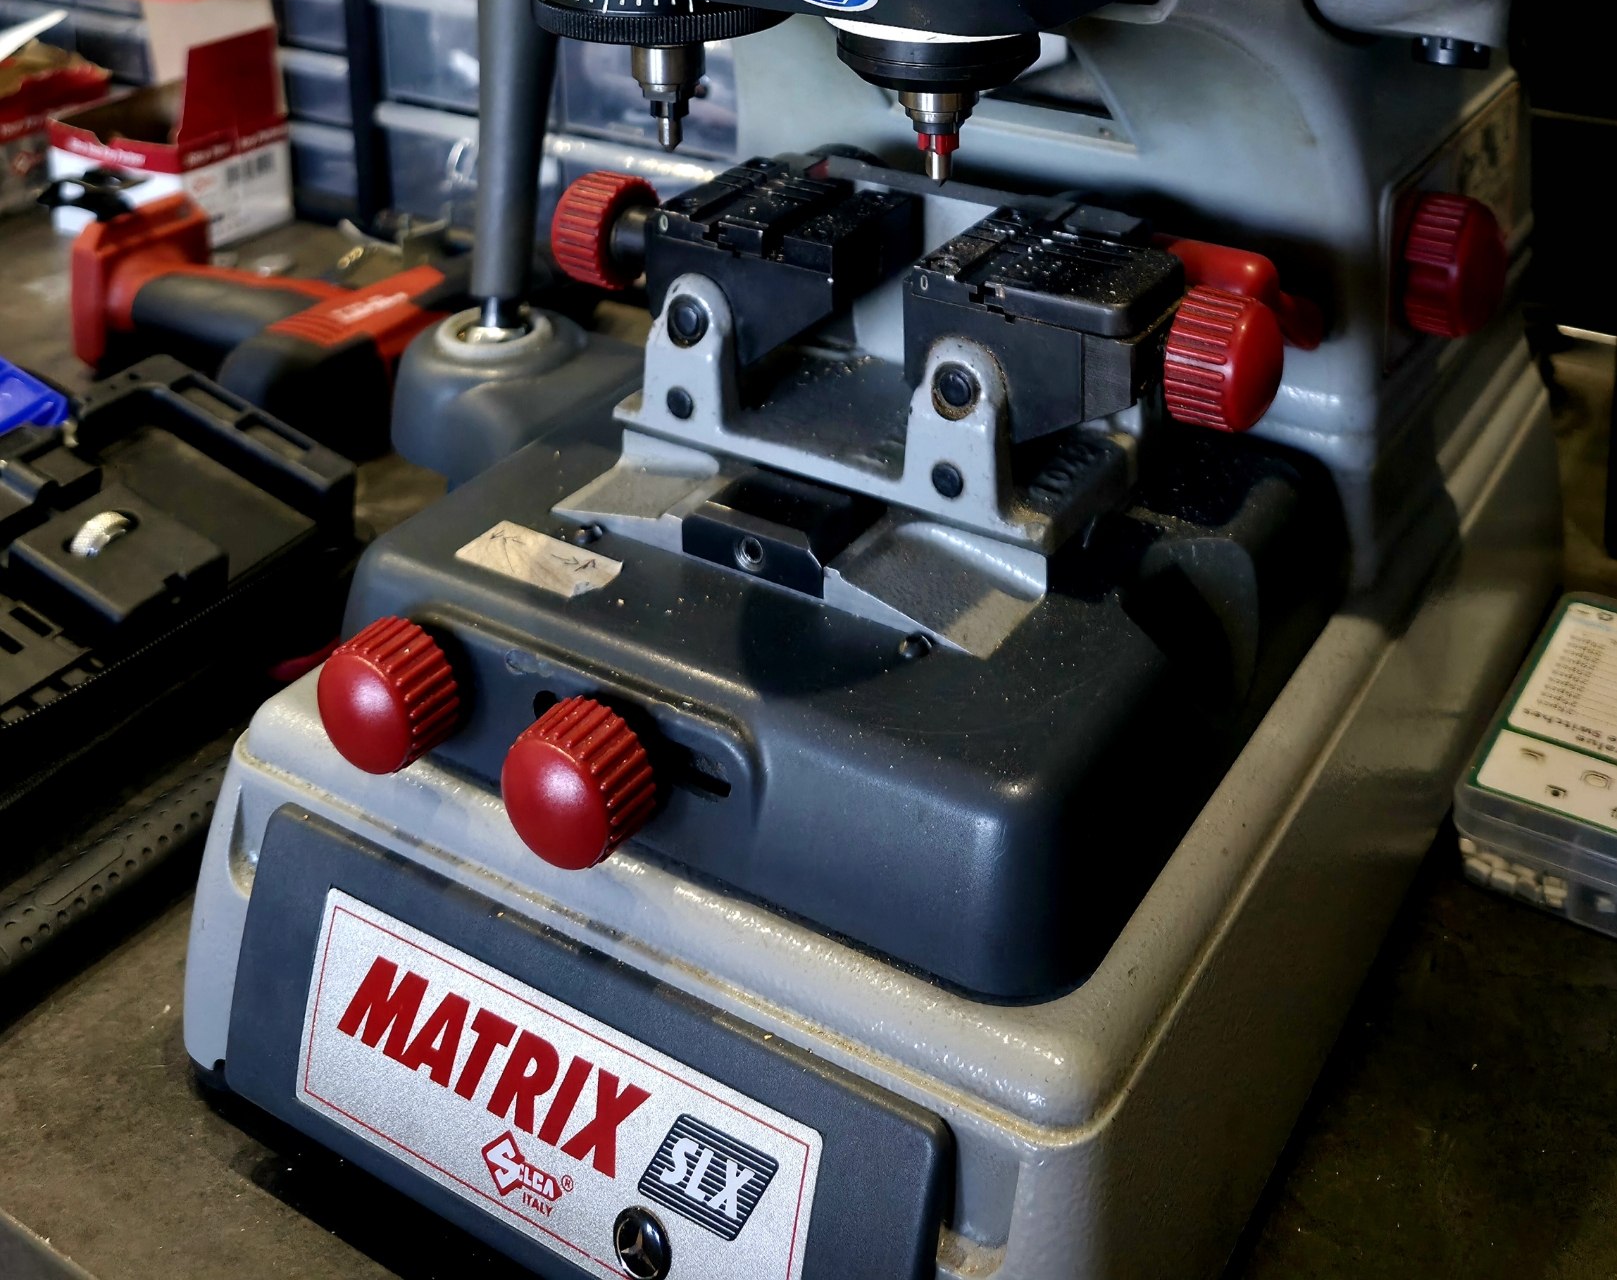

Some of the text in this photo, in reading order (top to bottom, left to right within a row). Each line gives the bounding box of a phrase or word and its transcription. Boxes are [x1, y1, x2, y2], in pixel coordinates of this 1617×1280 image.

[337, 956, 651, 1179] MATRIX
[522, 1192, 553, 1217] ITALY
[660, 1137, 755, 1221] SLX
